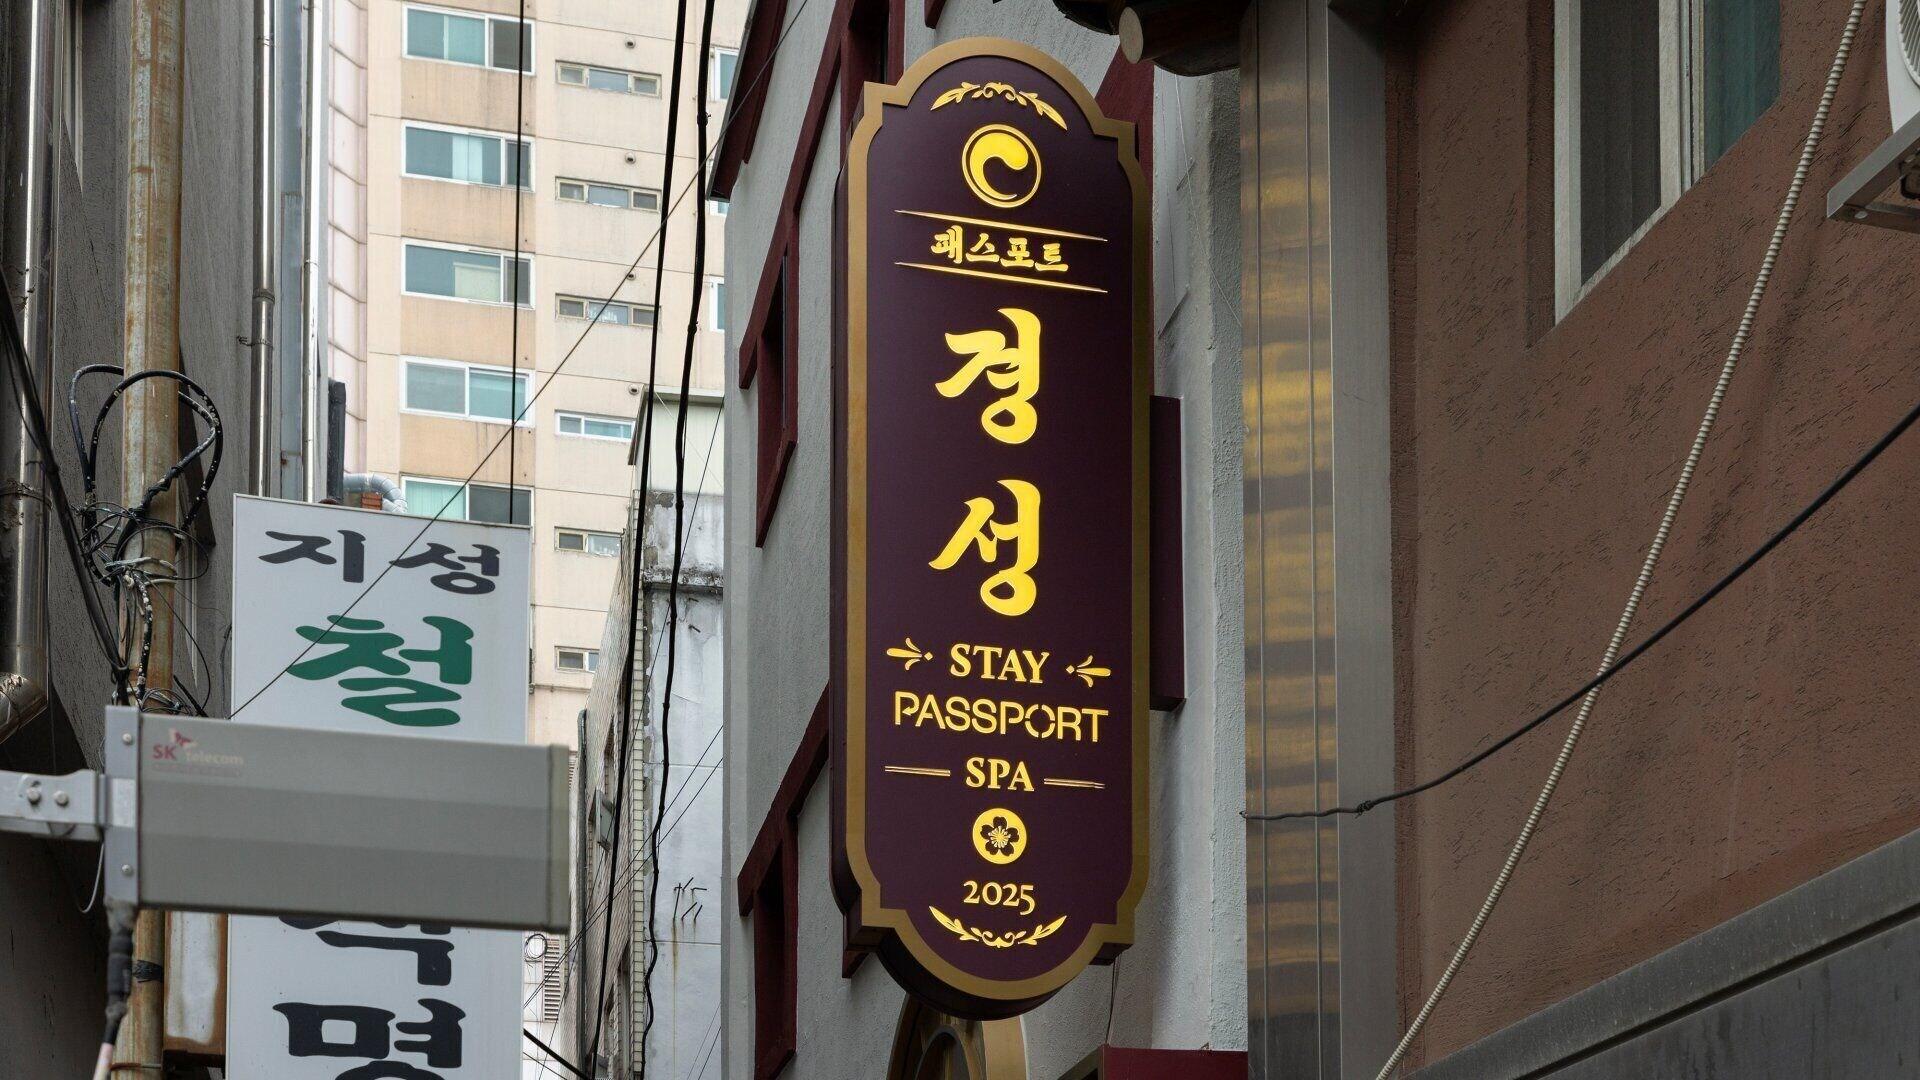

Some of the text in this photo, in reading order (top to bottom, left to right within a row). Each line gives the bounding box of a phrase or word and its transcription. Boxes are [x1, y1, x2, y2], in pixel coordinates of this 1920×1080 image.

[931, 225, 1069, 272] 패스포트
[928, 308, 1041, 617] 경성
[259, 530, 500, 595] 지성
[950, 643, 1050, 684] STAY
[894, 690, 1109, 742] PASSPORT
[152, 744, 176, 759] SK
[965, 756, 1035, 792] SPA
[963, 879, 1036, 916] 2025
